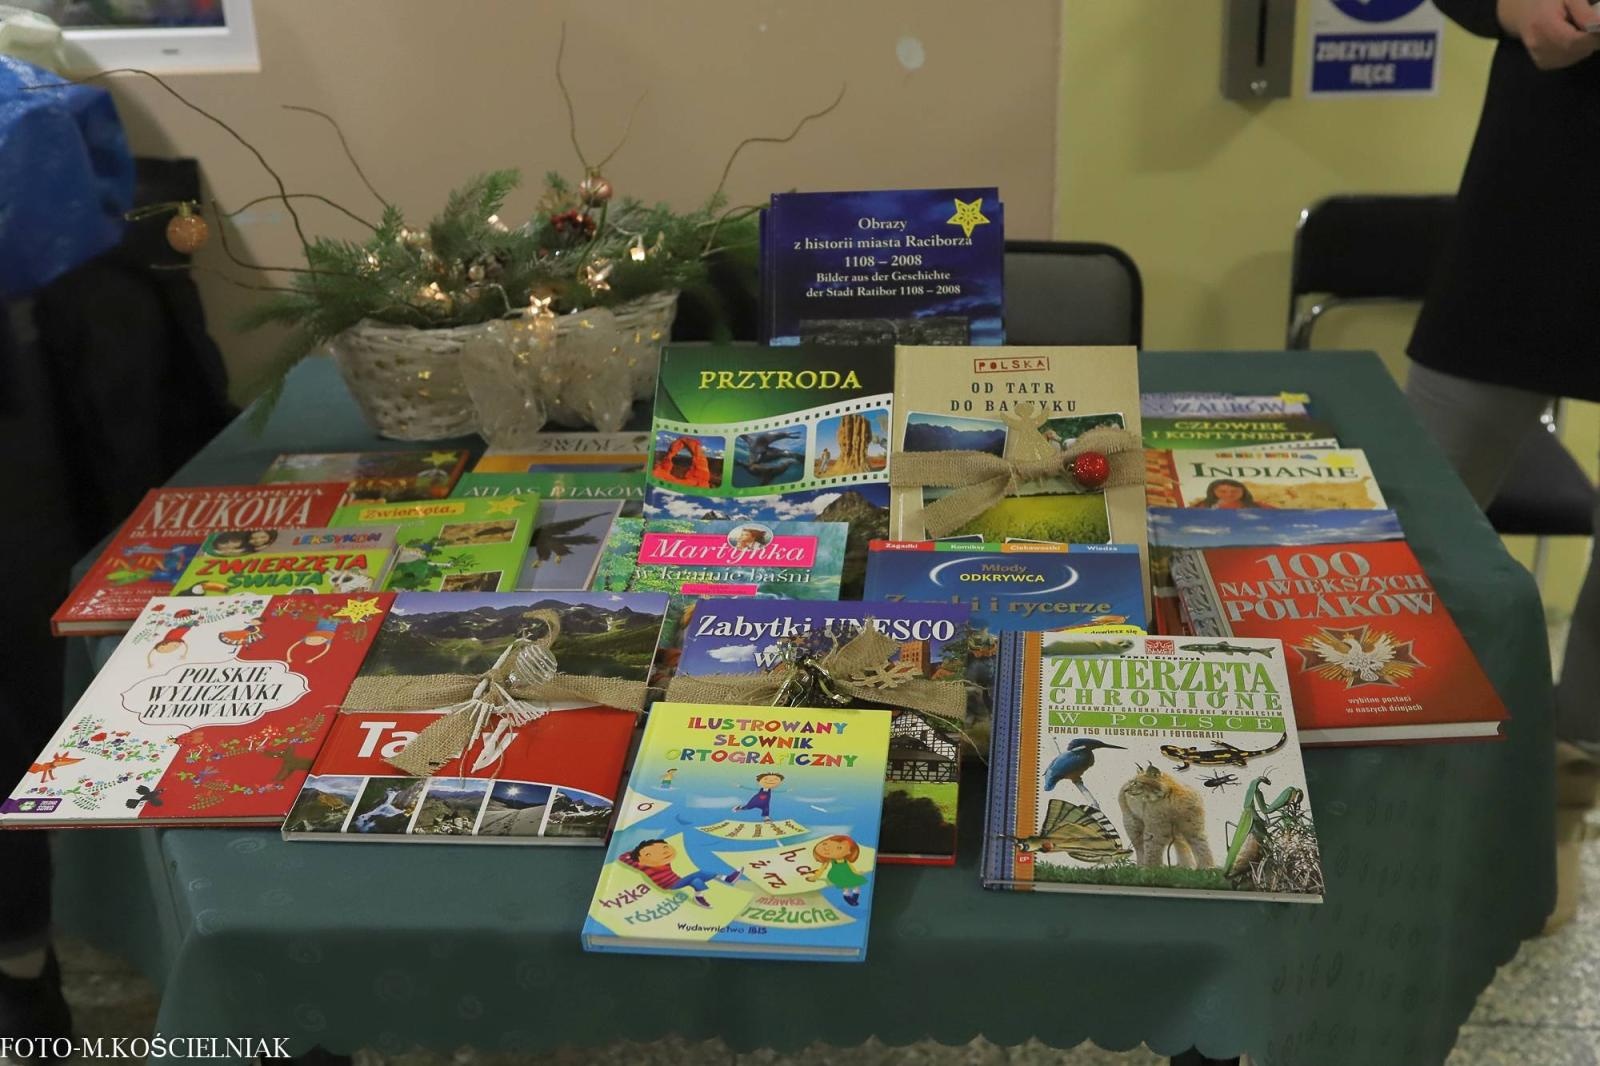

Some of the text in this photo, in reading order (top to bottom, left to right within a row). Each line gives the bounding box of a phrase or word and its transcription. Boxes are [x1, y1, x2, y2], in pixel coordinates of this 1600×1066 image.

[858, 217, 907, 232] Obrazy
[794, 235, 973, 249] z historii miasta Raciborza
[845, 256, 875, 267] 1108
[891, 254, 922, 266] 2008
[817, 271, 951, 282] Bilder aus der Geschichte
[806, 287, 823, 297] der
[826, 287, 853, 297] Stadt
[857, 286, 897, 296] Ratibor
[900, 285, 924, 296] 1108
[936, 284, 961, 295] 2008
[978, 359, 1046, 371] POLSKA
[698, 370, 862, 390] PRZYRODA
[971, 382, 1055, 394] OD TATR
[950, 399, 1077, 412] DO BAYKU
[1152, 431, 1314, 440] I KONTYNENTY
[1190, 462, 1359, 478] INDIANIE
[159, 488, 325, 501] ENCYKLOPEDIA
[135, 496, 313, 531] NAUKOWA
[292, 532, 382, 546] LEKSYKON
[650, 538, 806, 564] Martynka
[195, 553, 368, 577] ZWIERZĘTA
[981, 562, 1027, 574] Młody
[1255, 551, 1371, 580] 100
[660, 567, 742, 582] krainie
[750, 567, 812, 583] baśni
[959, 573, 1045, 583] ODKRYWCA
[1219, 574, 1429, 599] NAJWIĘKSZYCH
[1007, 600, 1113, 617] rycerze
[1223, 591, 1436, 622] POLAKÓW
[695, 615, 812, 642] Zabytki
[178, 666, 272, 684] POLSKIE
[1049, 657, 1279, 695] ZWIERZĘTA
[1049, 687, 1283, 710] CHRONIONE
[1347, 695, 1411, 704] wybitne postaci
[142, 702, 264, 719] RYMOWANKI
[1356, 704, 1388, 714] naszych
[688, 717, 848, 734] ILUSTROWANY
[1055, 712, 1273, 730] W POLSCE
[1048, 727, 1079, 735] PONAD
[1083, 727, 1100, 735] 150
[1105, 728, 1159, 737] ILUSTRACJI
[1170, 730, 1224, 738] FOTOGRAFII
[713, 734, 814, 750] SŁOWNIK
[665, 748, 859, 767] ORTOGRAFICZNY
[599, 882, 651, 911] łyżka
[624, 891, 690, 925] różdżka
[741, 905, 840, 925] rzeżucha
[677, 922, 768, 935] Wydawnictwo IBIS
